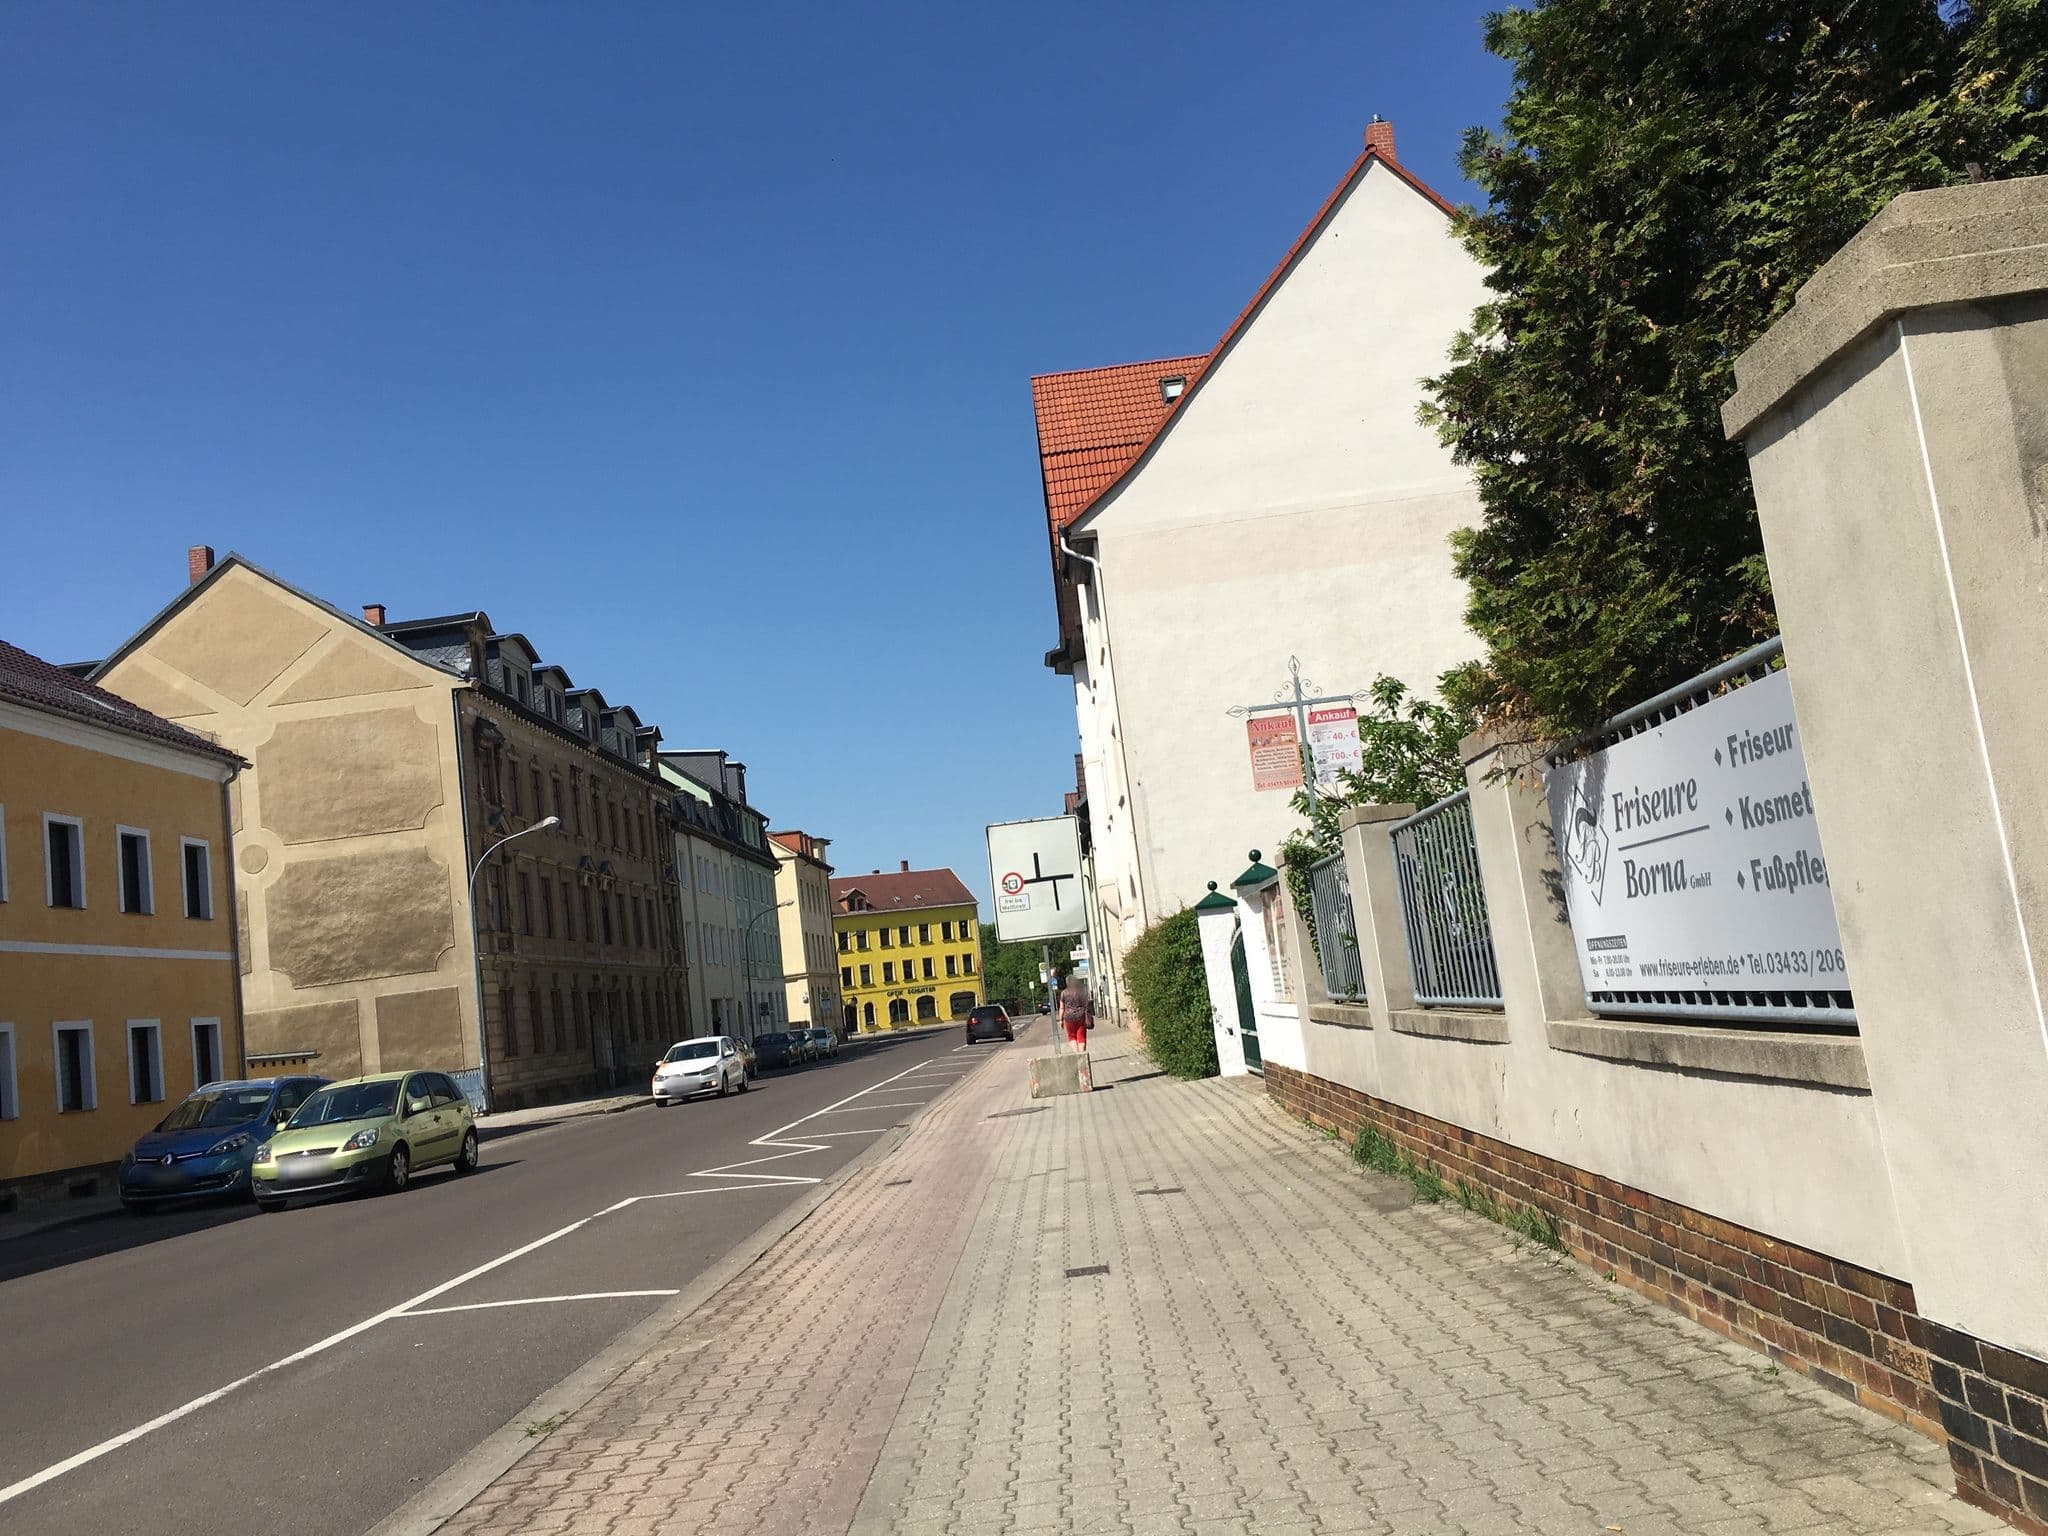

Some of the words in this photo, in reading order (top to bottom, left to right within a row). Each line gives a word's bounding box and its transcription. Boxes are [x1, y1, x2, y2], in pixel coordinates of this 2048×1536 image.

[1253, 719, 1292, 731] Ankauf
[1315, 710, 1350, 721] Ankauf
[1727, 722, 1794, 768] Friseur
[1611, 777, 1698, 832] Friseure
[1624, 857, 1688, 899] Borna
[1690, 871, 1712, 889] GmbH
[1640, 956, 1740, 978] www.friseure-erleben.de
